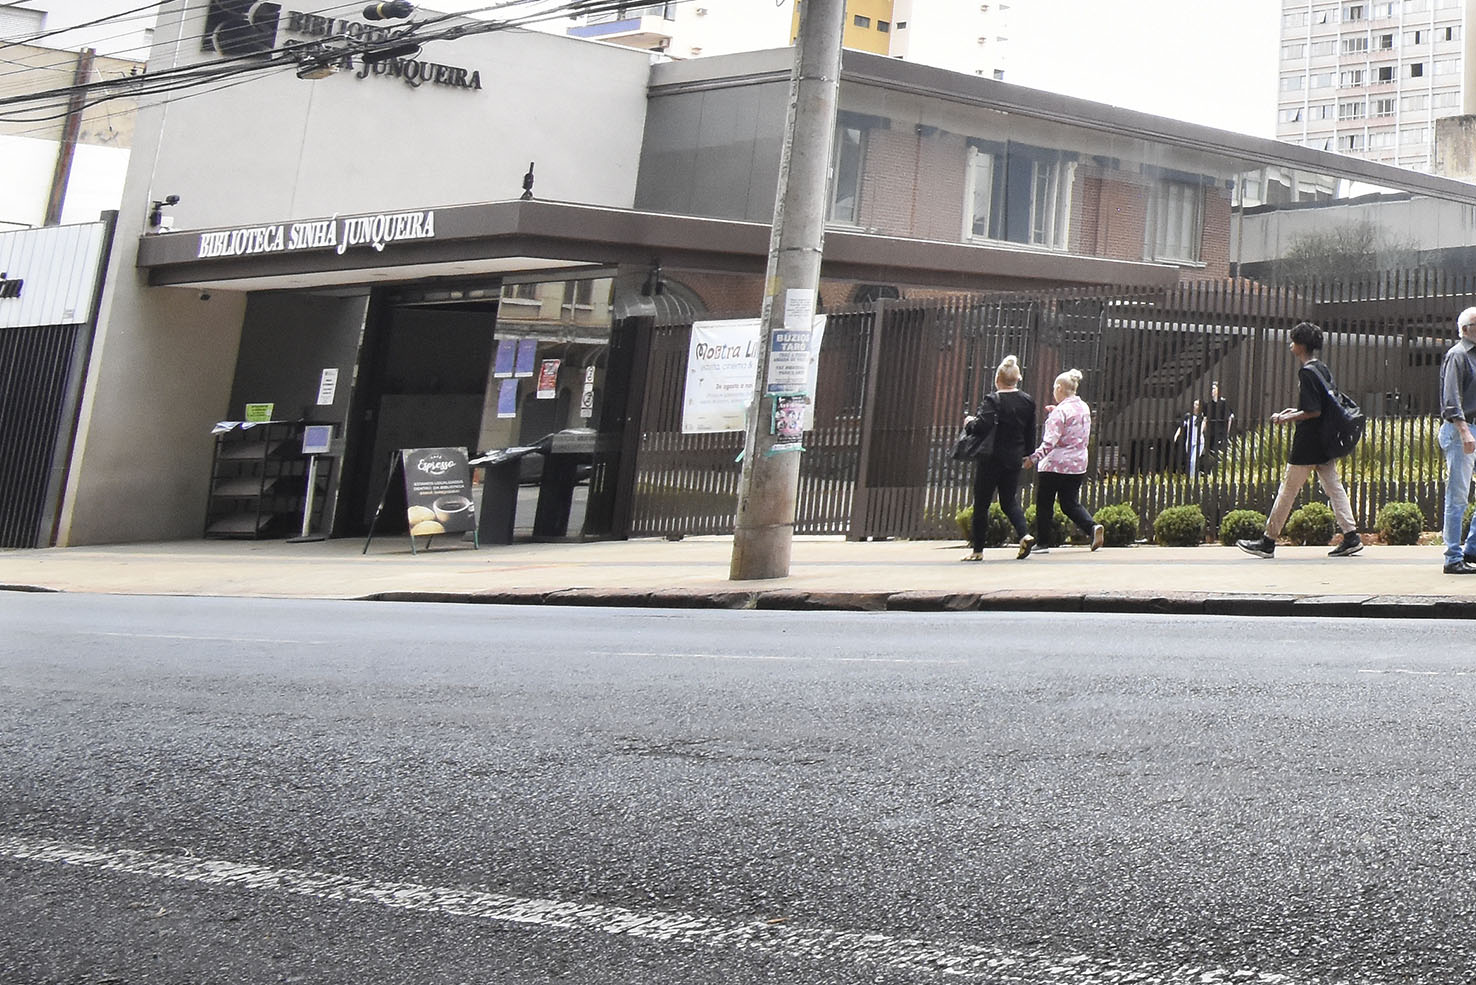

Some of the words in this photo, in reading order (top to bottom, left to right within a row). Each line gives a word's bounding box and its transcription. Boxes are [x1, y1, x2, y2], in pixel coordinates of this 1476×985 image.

[198, 224, 285, 258] BIBLIOTECA
[287, 212, 338, 250] SINHÁ
[335, 210, 435, 255] JUNQUEIRA
[417, 459, 456, 473] Espresso
